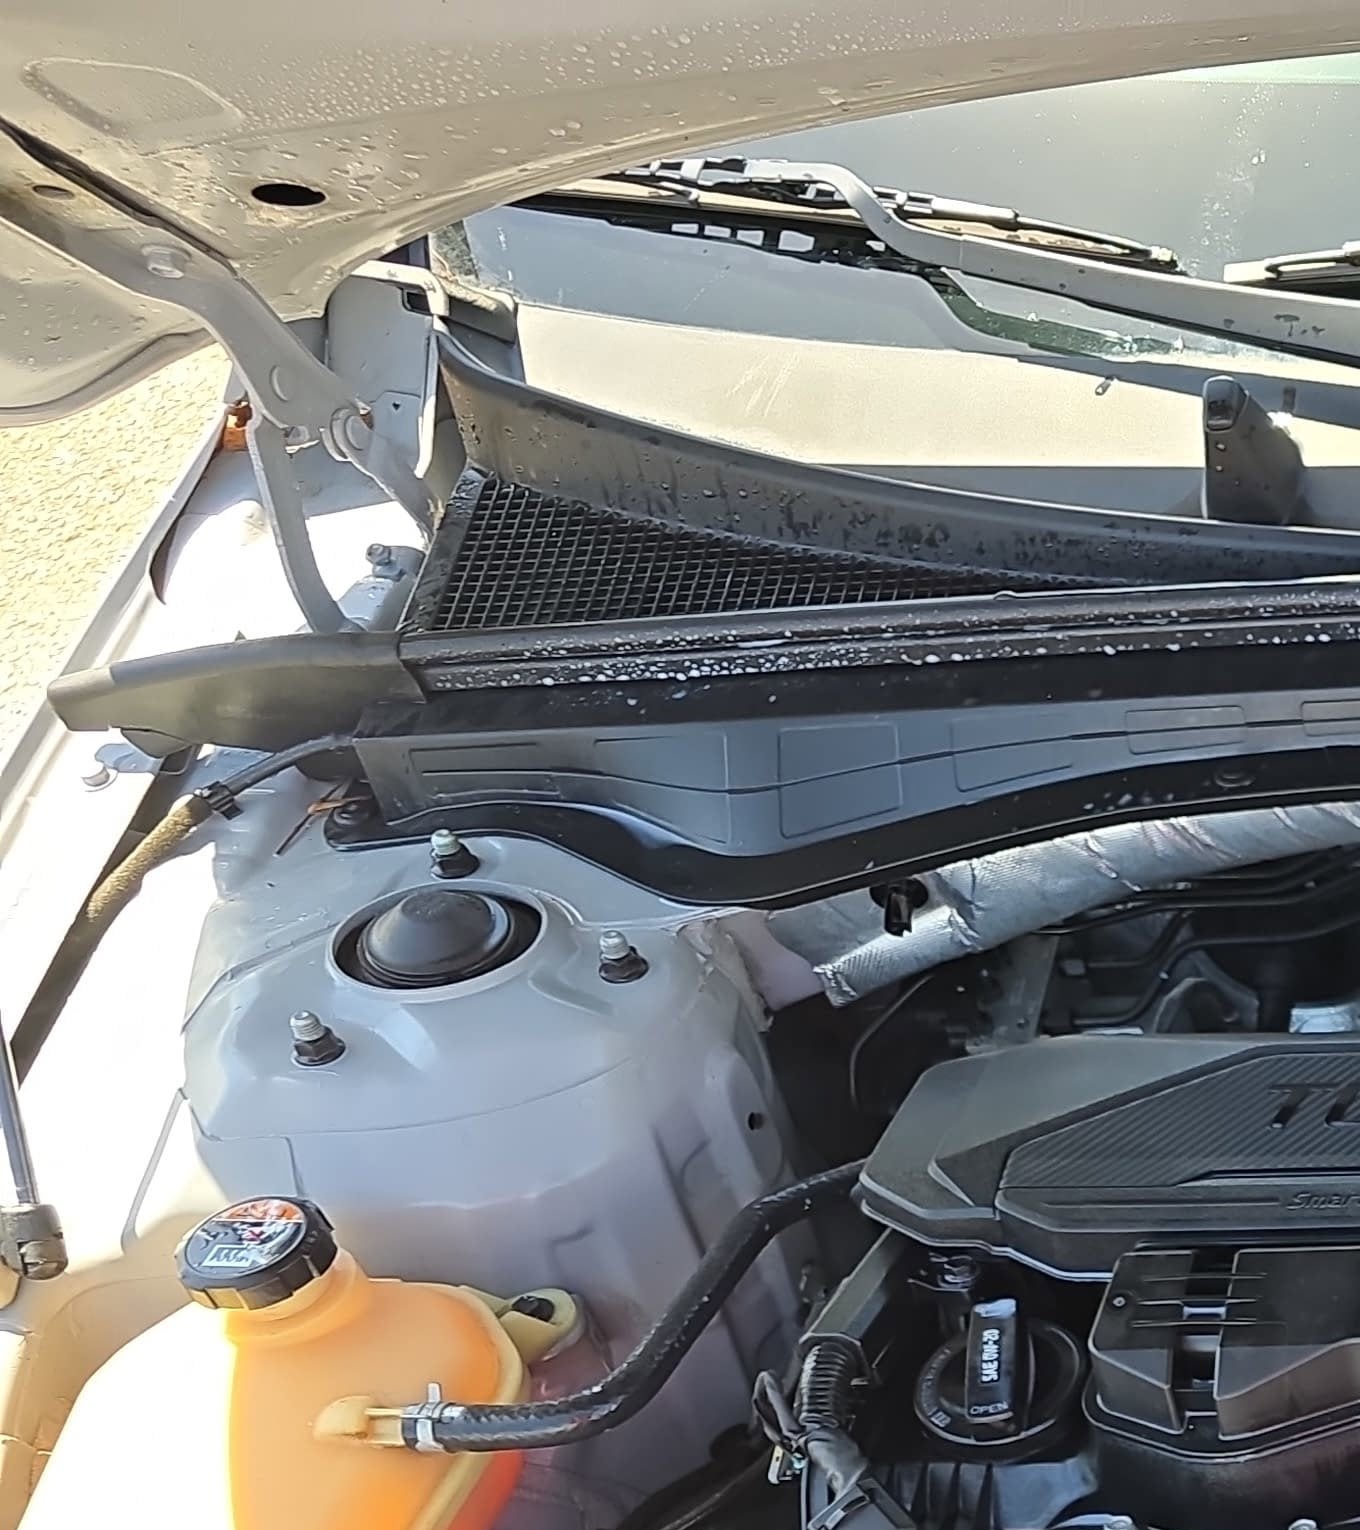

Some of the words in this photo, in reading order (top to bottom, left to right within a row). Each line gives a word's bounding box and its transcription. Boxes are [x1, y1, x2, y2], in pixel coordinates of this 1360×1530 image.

[981, 1328, 1001, 1361] 0W-20
[981, 1361, 999, 1382] SAE
[970, 1401, 1009, 1415] OPEN
